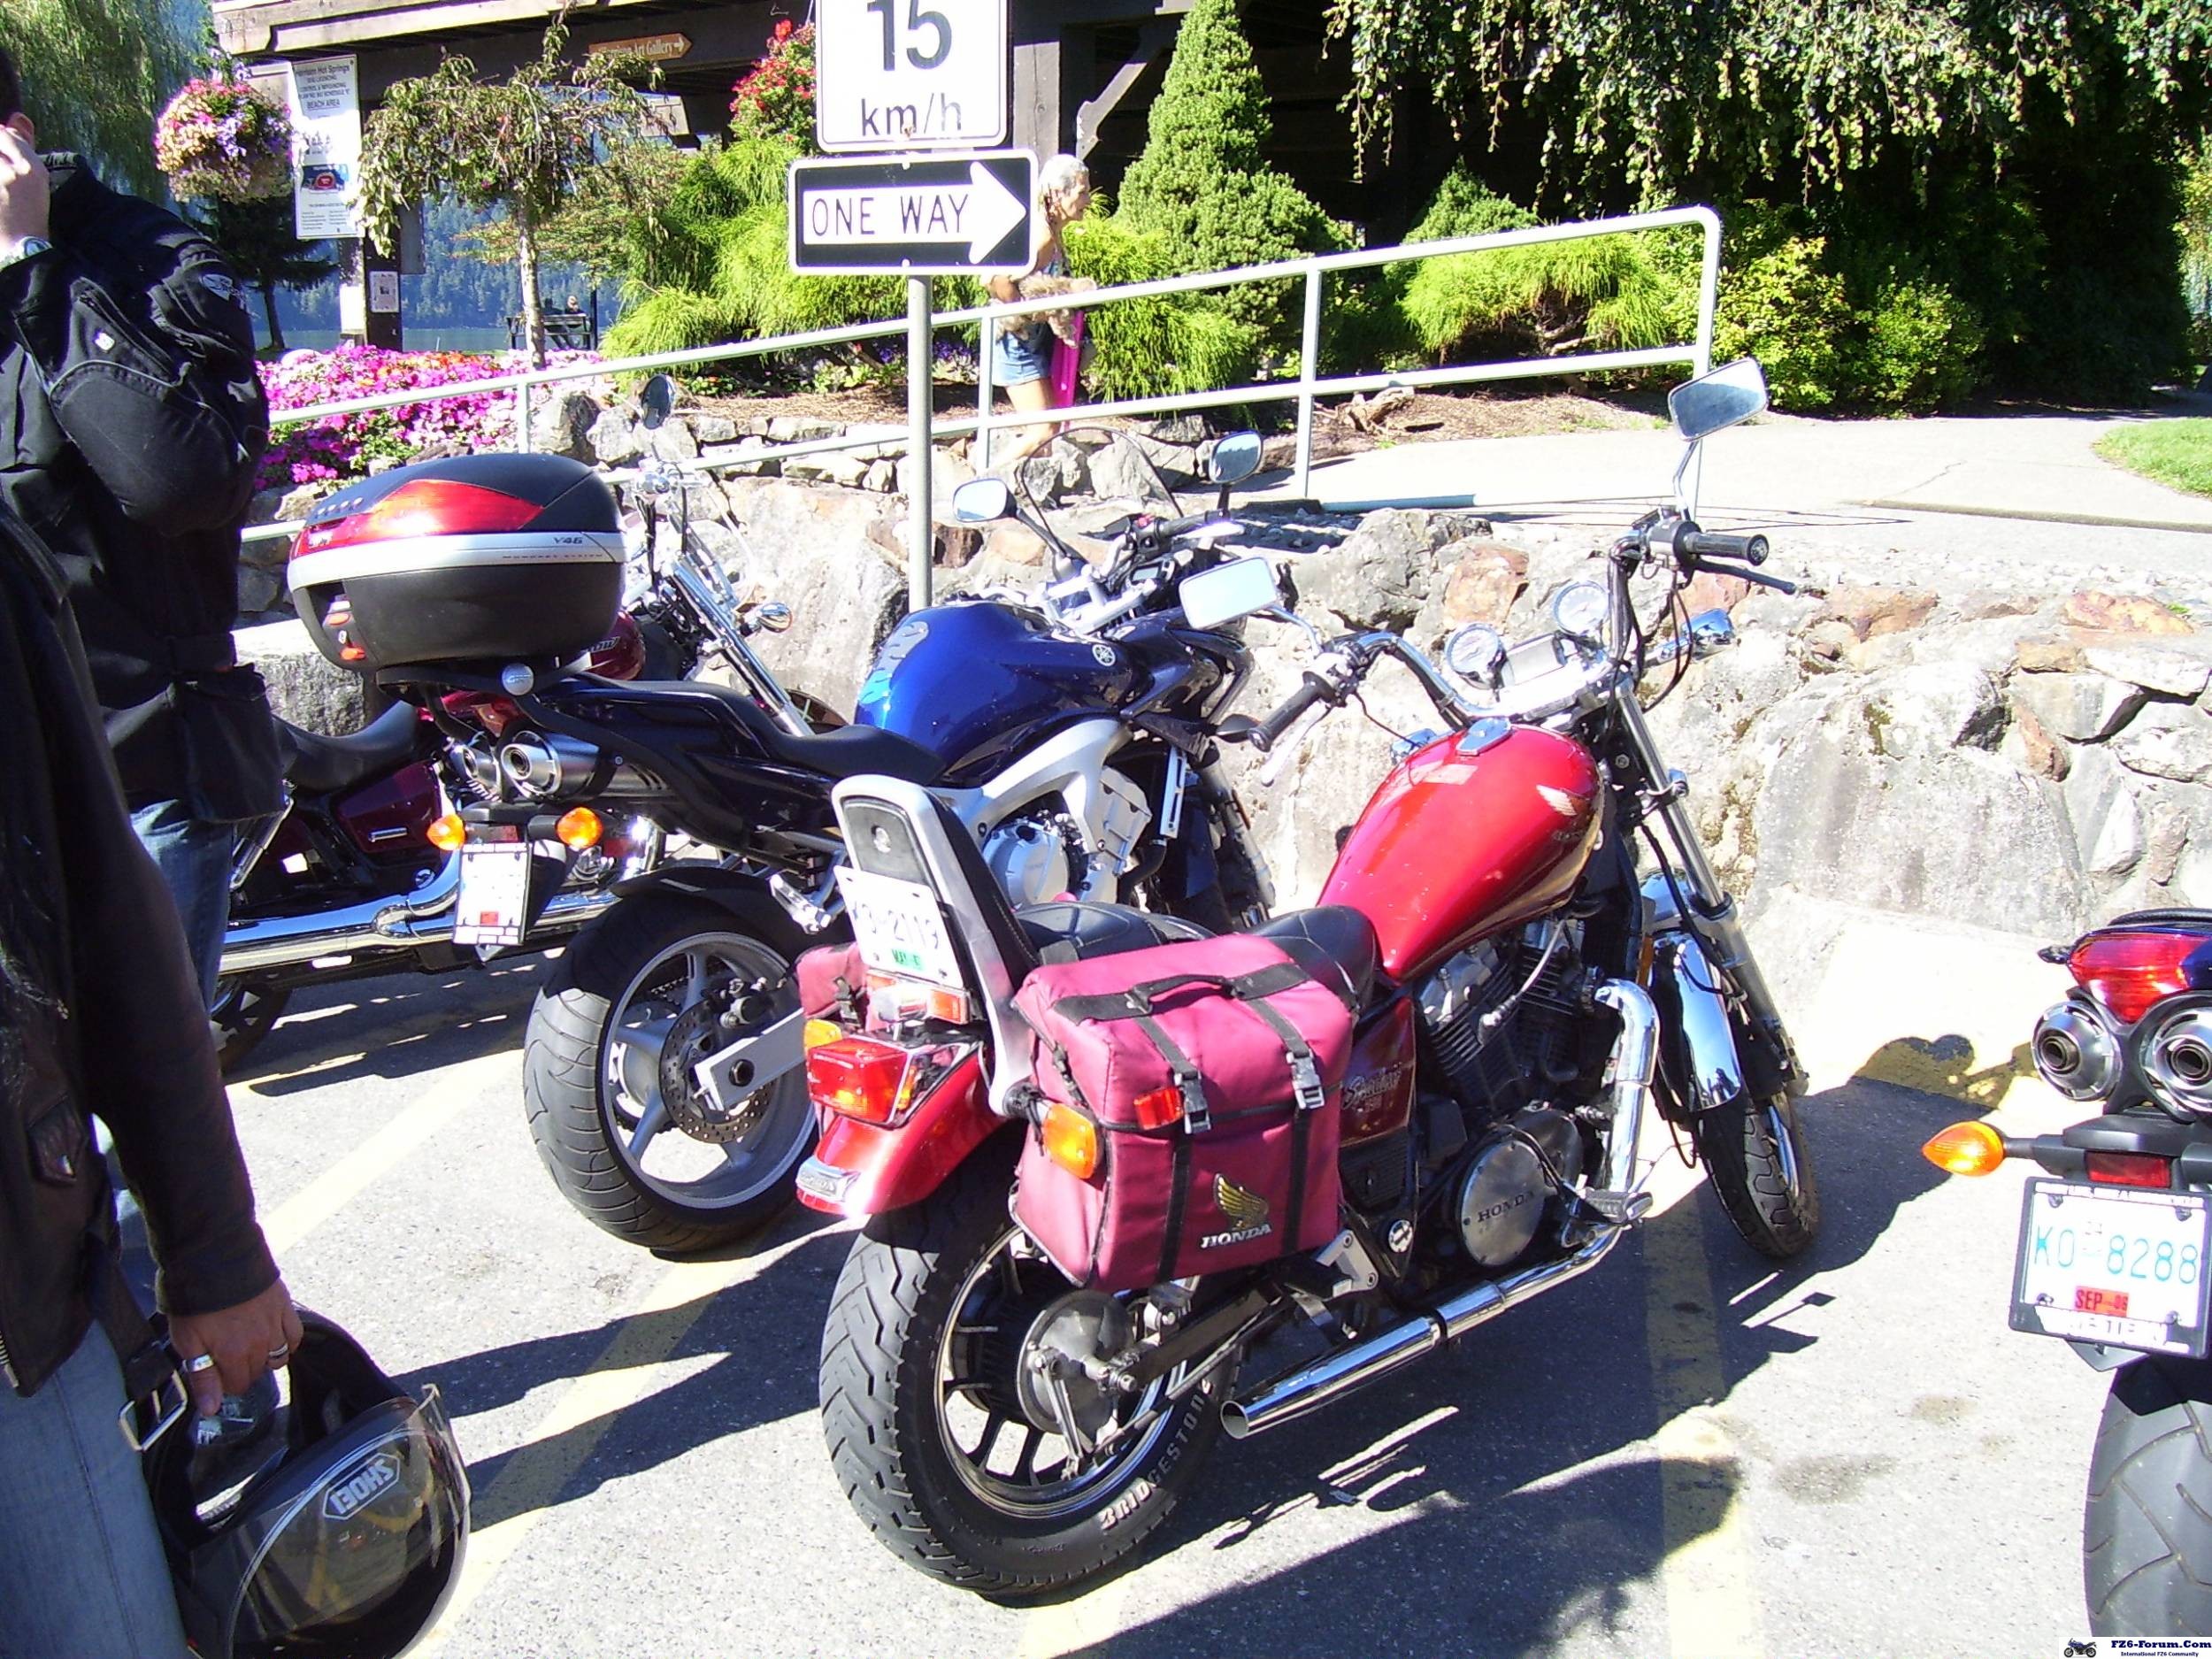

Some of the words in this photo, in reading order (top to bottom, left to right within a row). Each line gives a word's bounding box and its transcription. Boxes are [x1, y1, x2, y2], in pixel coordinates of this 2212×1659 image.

[646, 38, 672, 58] Gallery
[867, 0, 952, 71] 15
[328, 65, 350, 74] Springs
[862, 93, 962, 136] km/h
[812, 196, 875, 236] ONE
[901, 194, 968, 234] WAY
[1478, 1191, 1536, 1223] HONDA
[1200, 1223, 1272, 1248] HONDA
[2074, 1289, 2103, 1310] SEP
[329, 1459, 394, 1515] SHOEI
